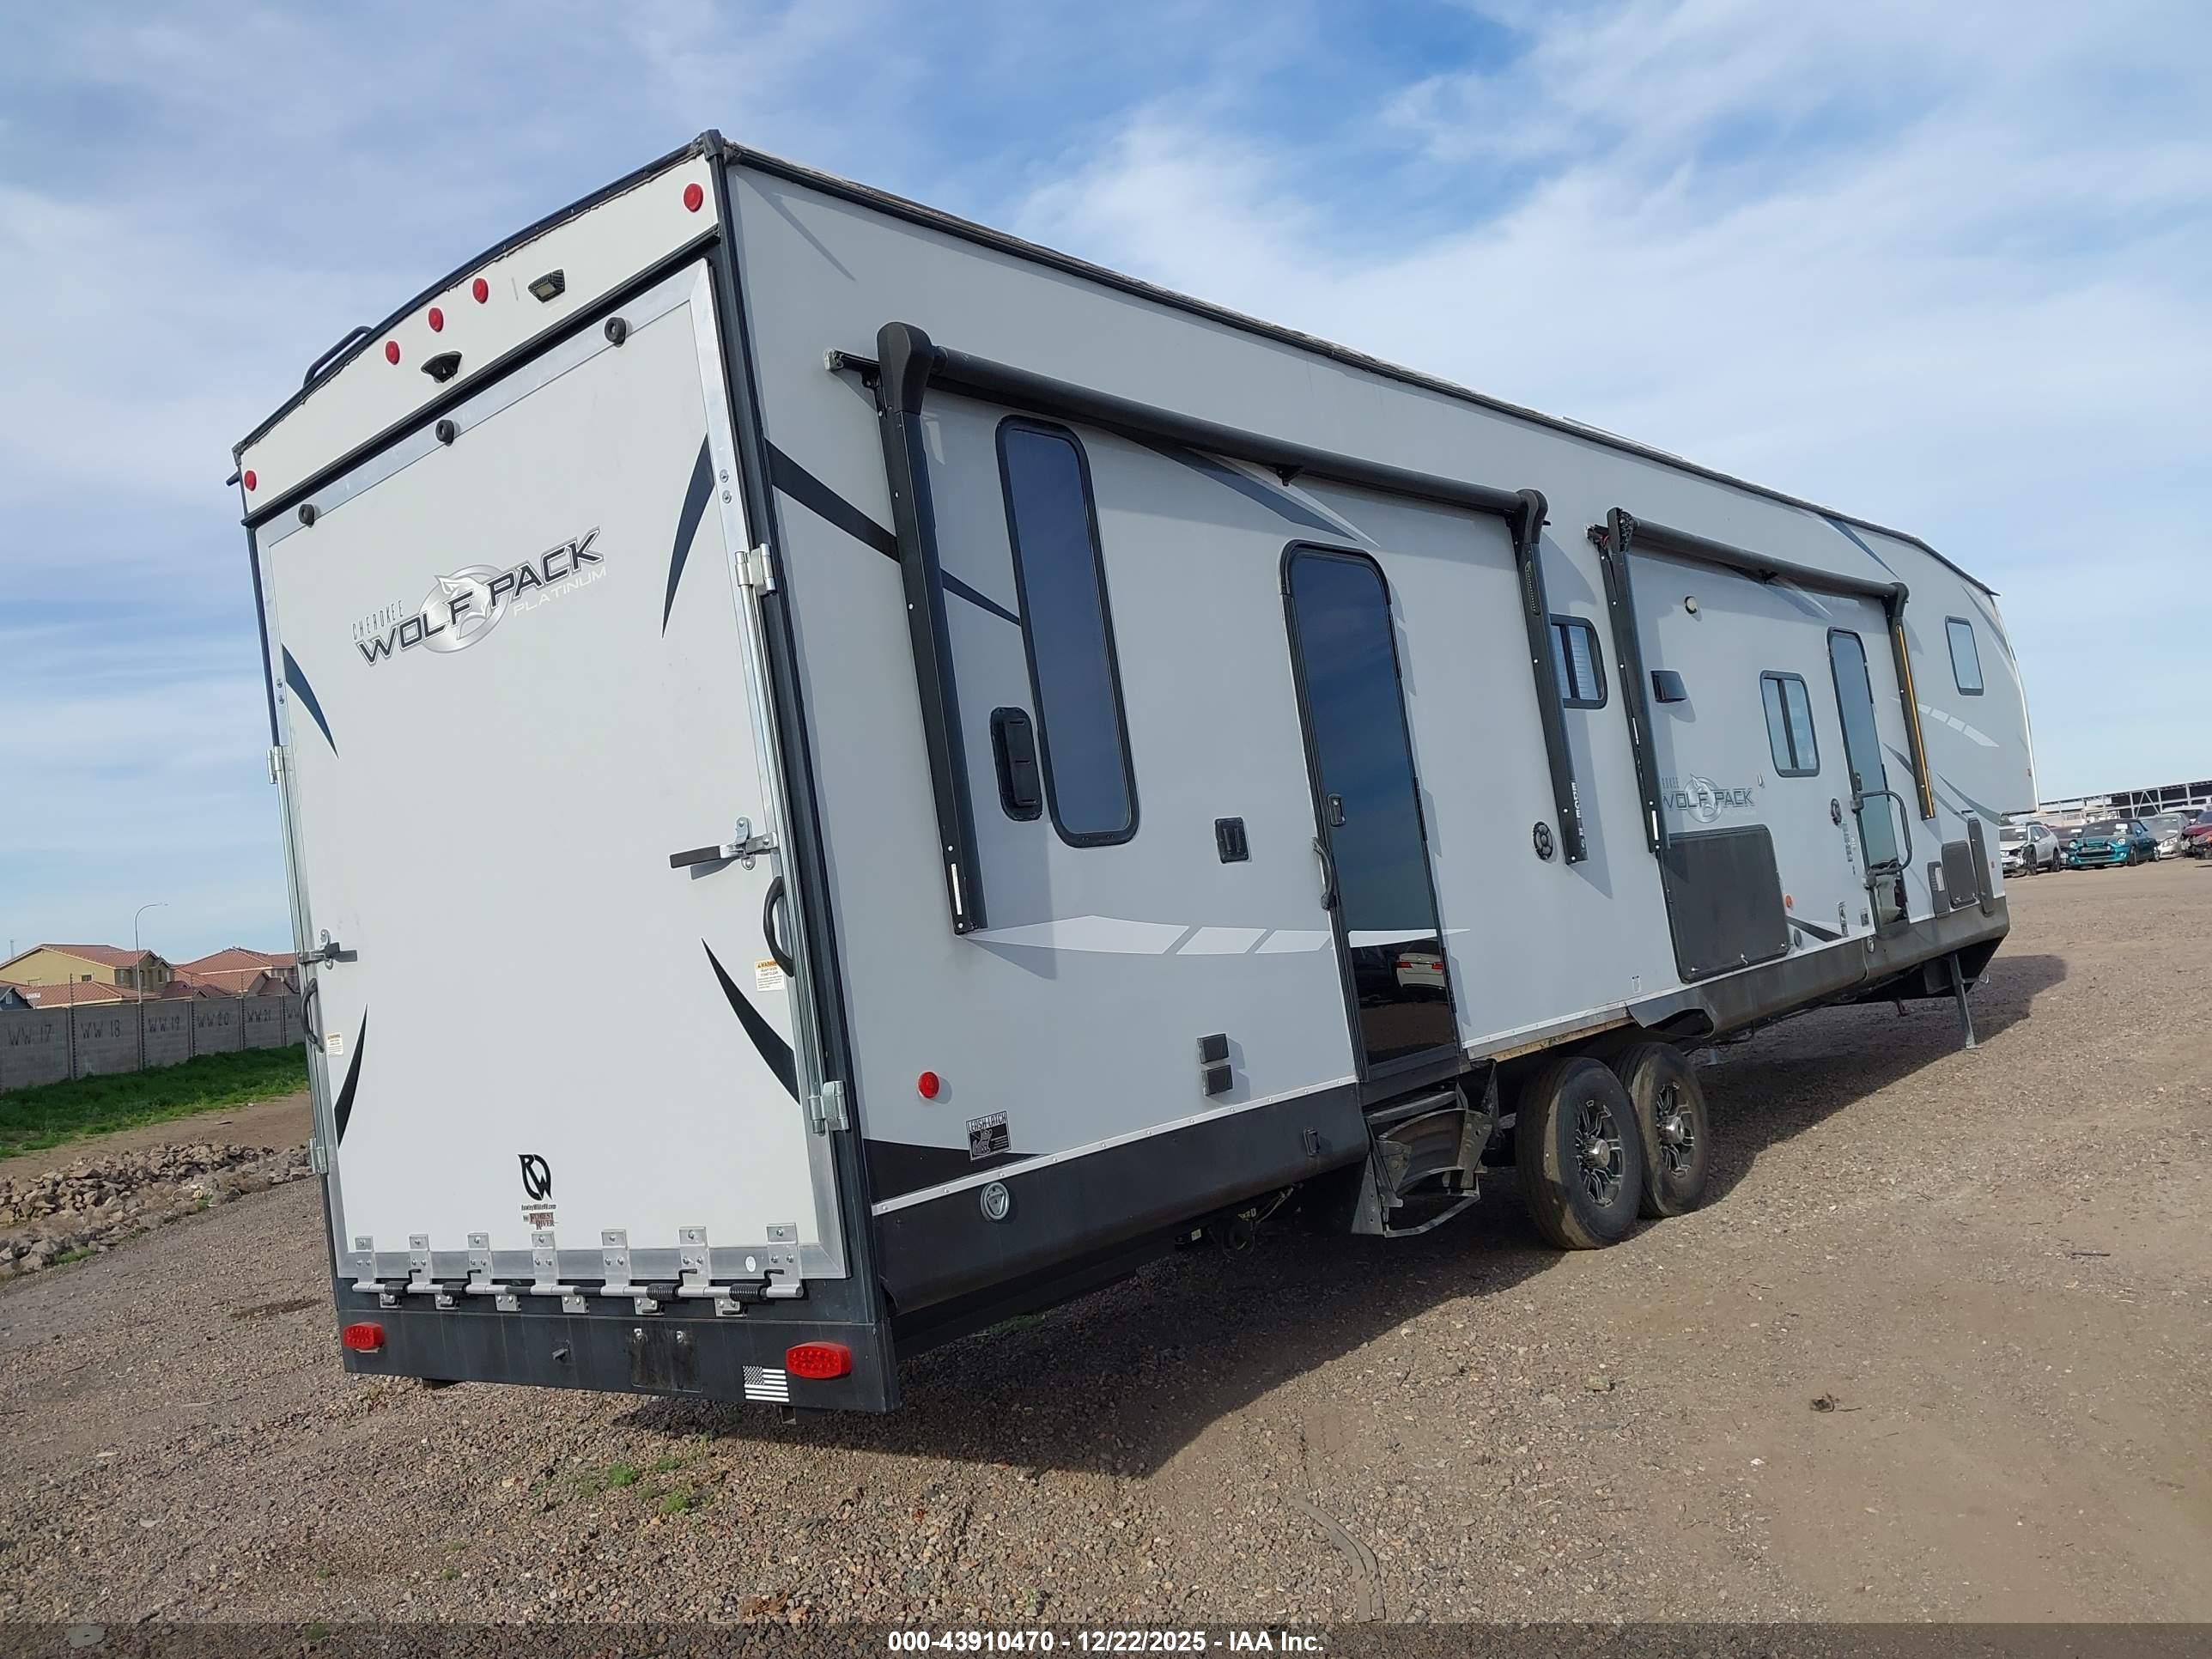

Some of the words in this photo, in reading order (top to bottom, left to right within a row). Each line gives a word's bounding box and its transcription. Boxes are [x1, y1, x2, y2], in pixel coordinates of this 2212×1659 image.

[355, 589, 474, 666] WOLF
[479, 525, 605, 611] PACK
[514, 567, 607, 617] PLATINUM
[352, 600, 404, 641] CHEROKEE
[1713, 788, 1755, 807] PACK
[110, 1019, 121, 1037] 18
[536, 1219, 555, 1230] RIVER
